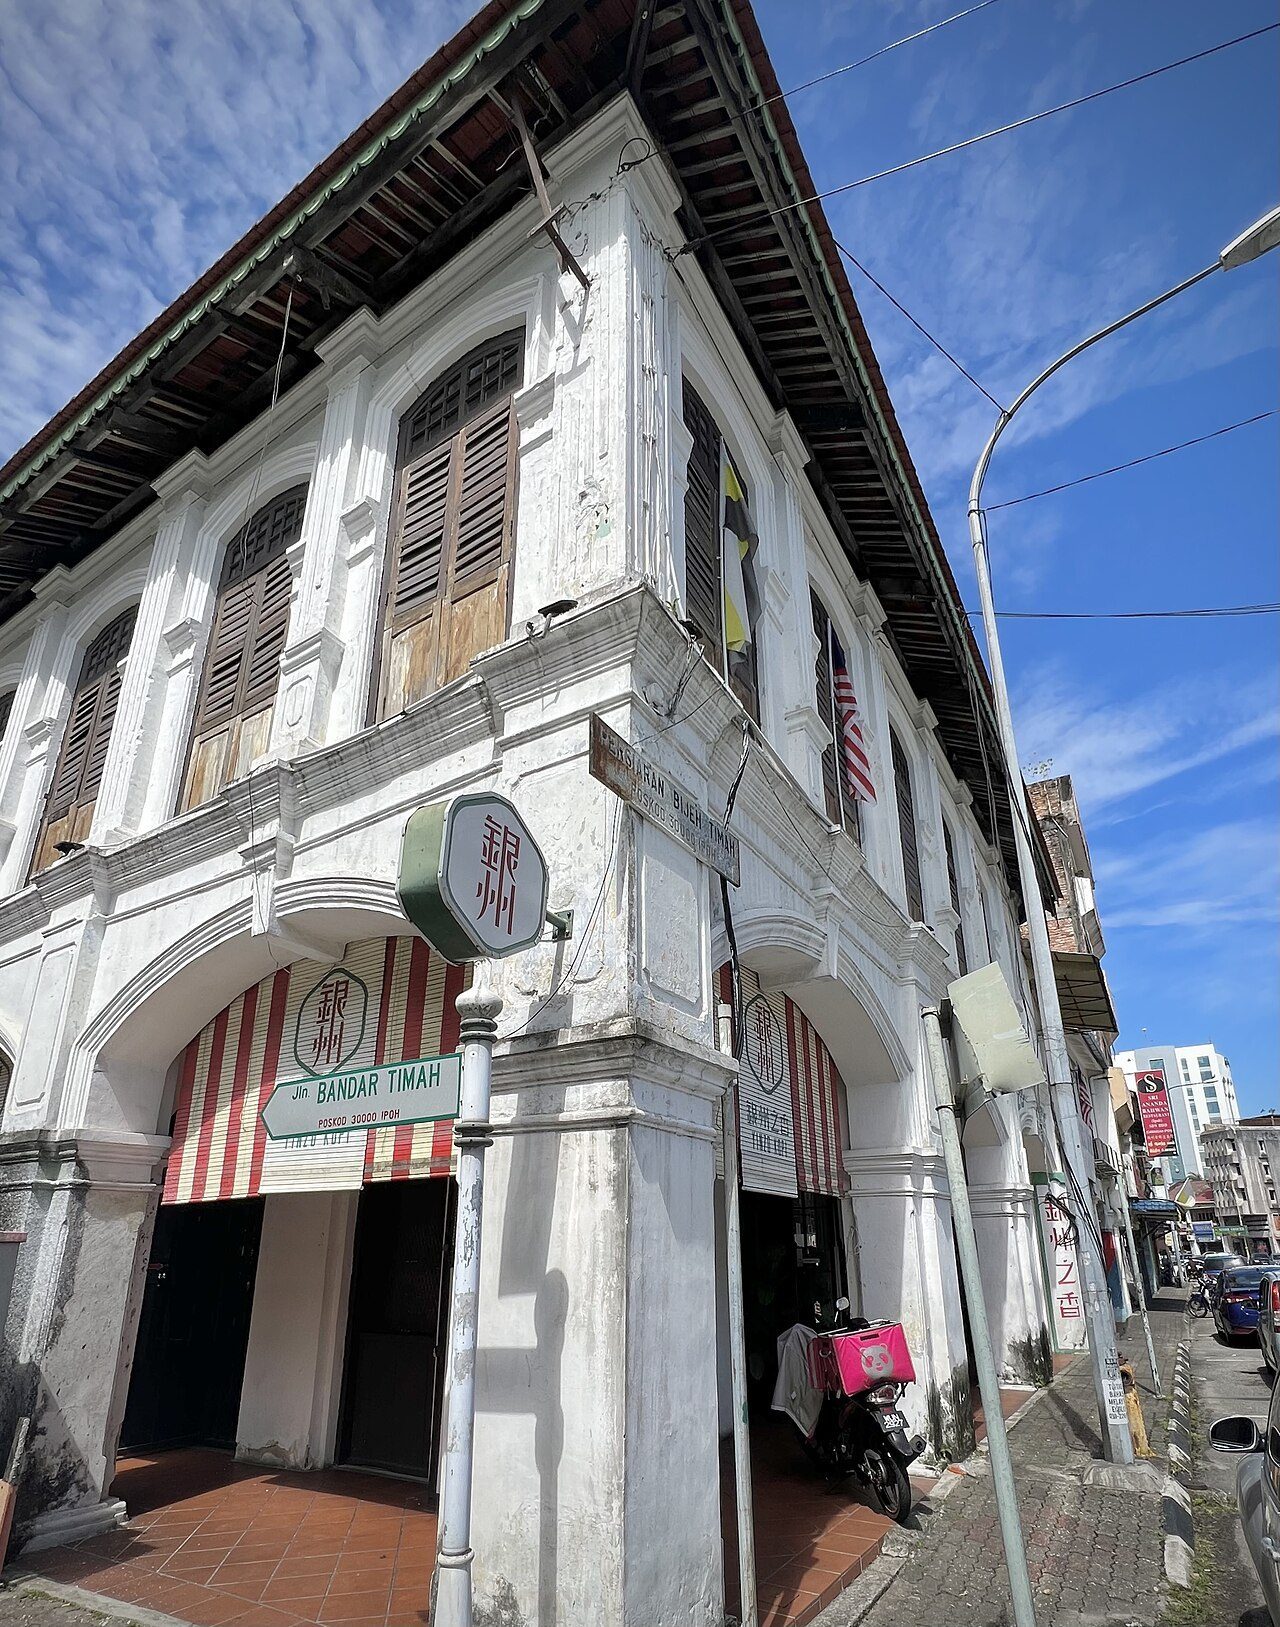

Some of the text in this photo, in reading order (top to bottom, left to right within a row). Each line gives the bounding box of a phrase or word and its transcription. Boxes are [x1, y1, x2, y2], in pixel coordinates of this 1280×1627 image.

[668, 813, 697, 846] 30000
[673, 789, 703, 830] BIJEH
[708, 820, 736, 859] TIMAH
[291, 1062, 441, 1105] Jln. BANDAR TIMAH
[318, 1108, 401, 1130] POSKOD 30000 IPOH
